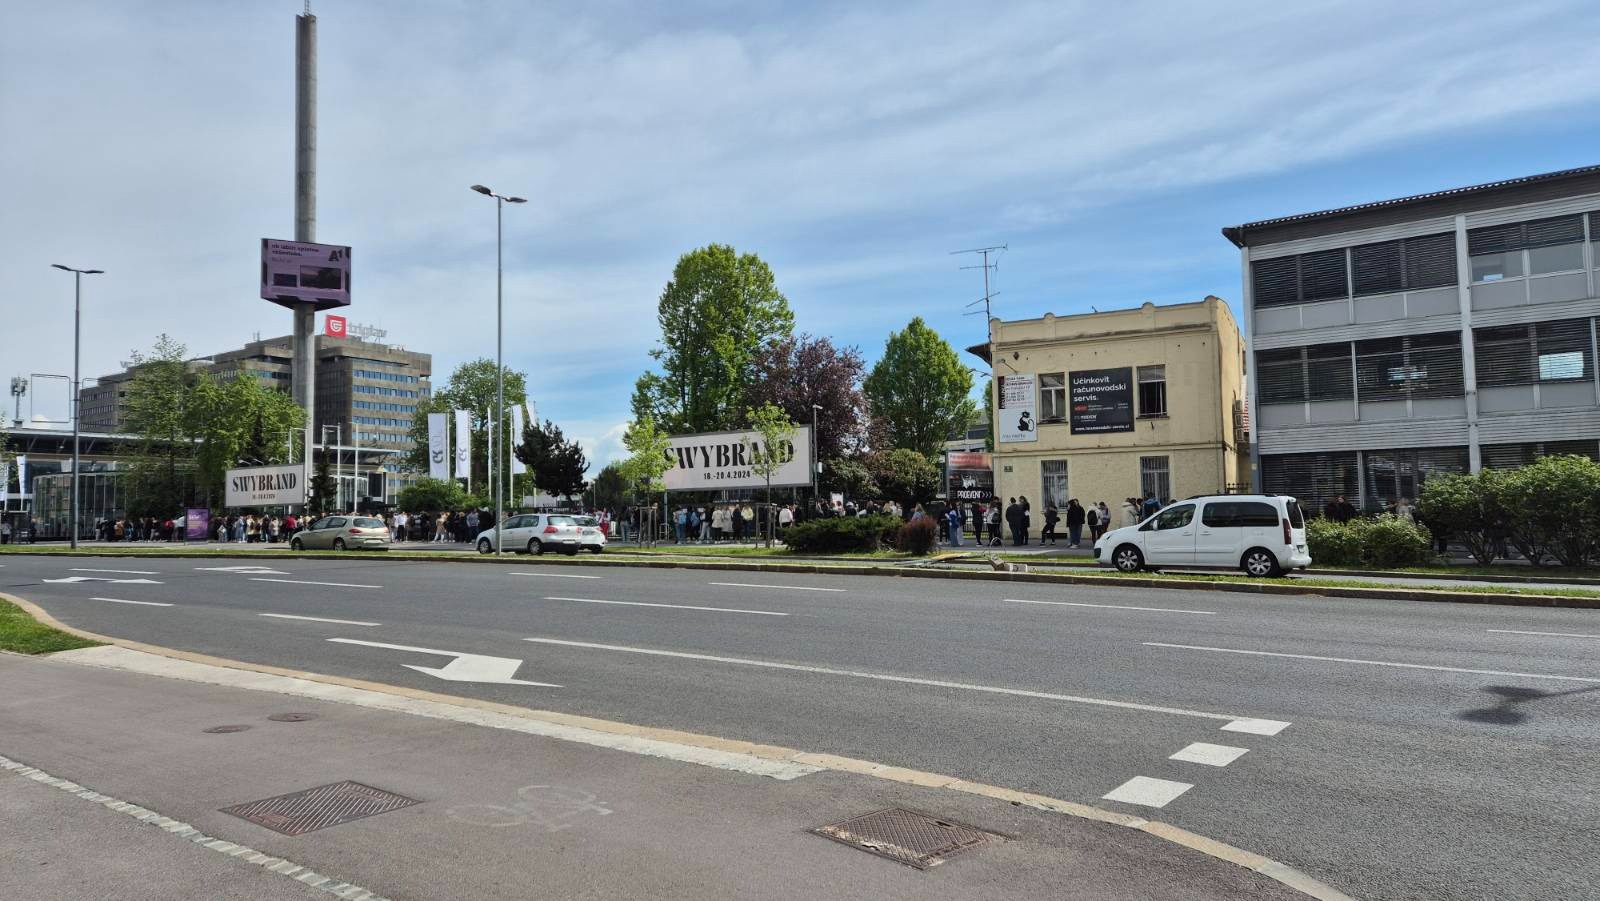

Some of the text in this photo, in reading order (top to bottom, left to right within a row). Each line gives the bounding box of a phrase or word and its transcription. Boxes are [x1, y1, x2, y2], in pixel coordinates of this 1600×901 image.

[328, 249, 343, 262] A1
[1073, 376, 1110, 385] Učinkovit
[1073, 383, 1127, 394] računovodski
[232, 472, 297, 492] SWYBRAND
[957, 490, 981, 499] PROEVENT
